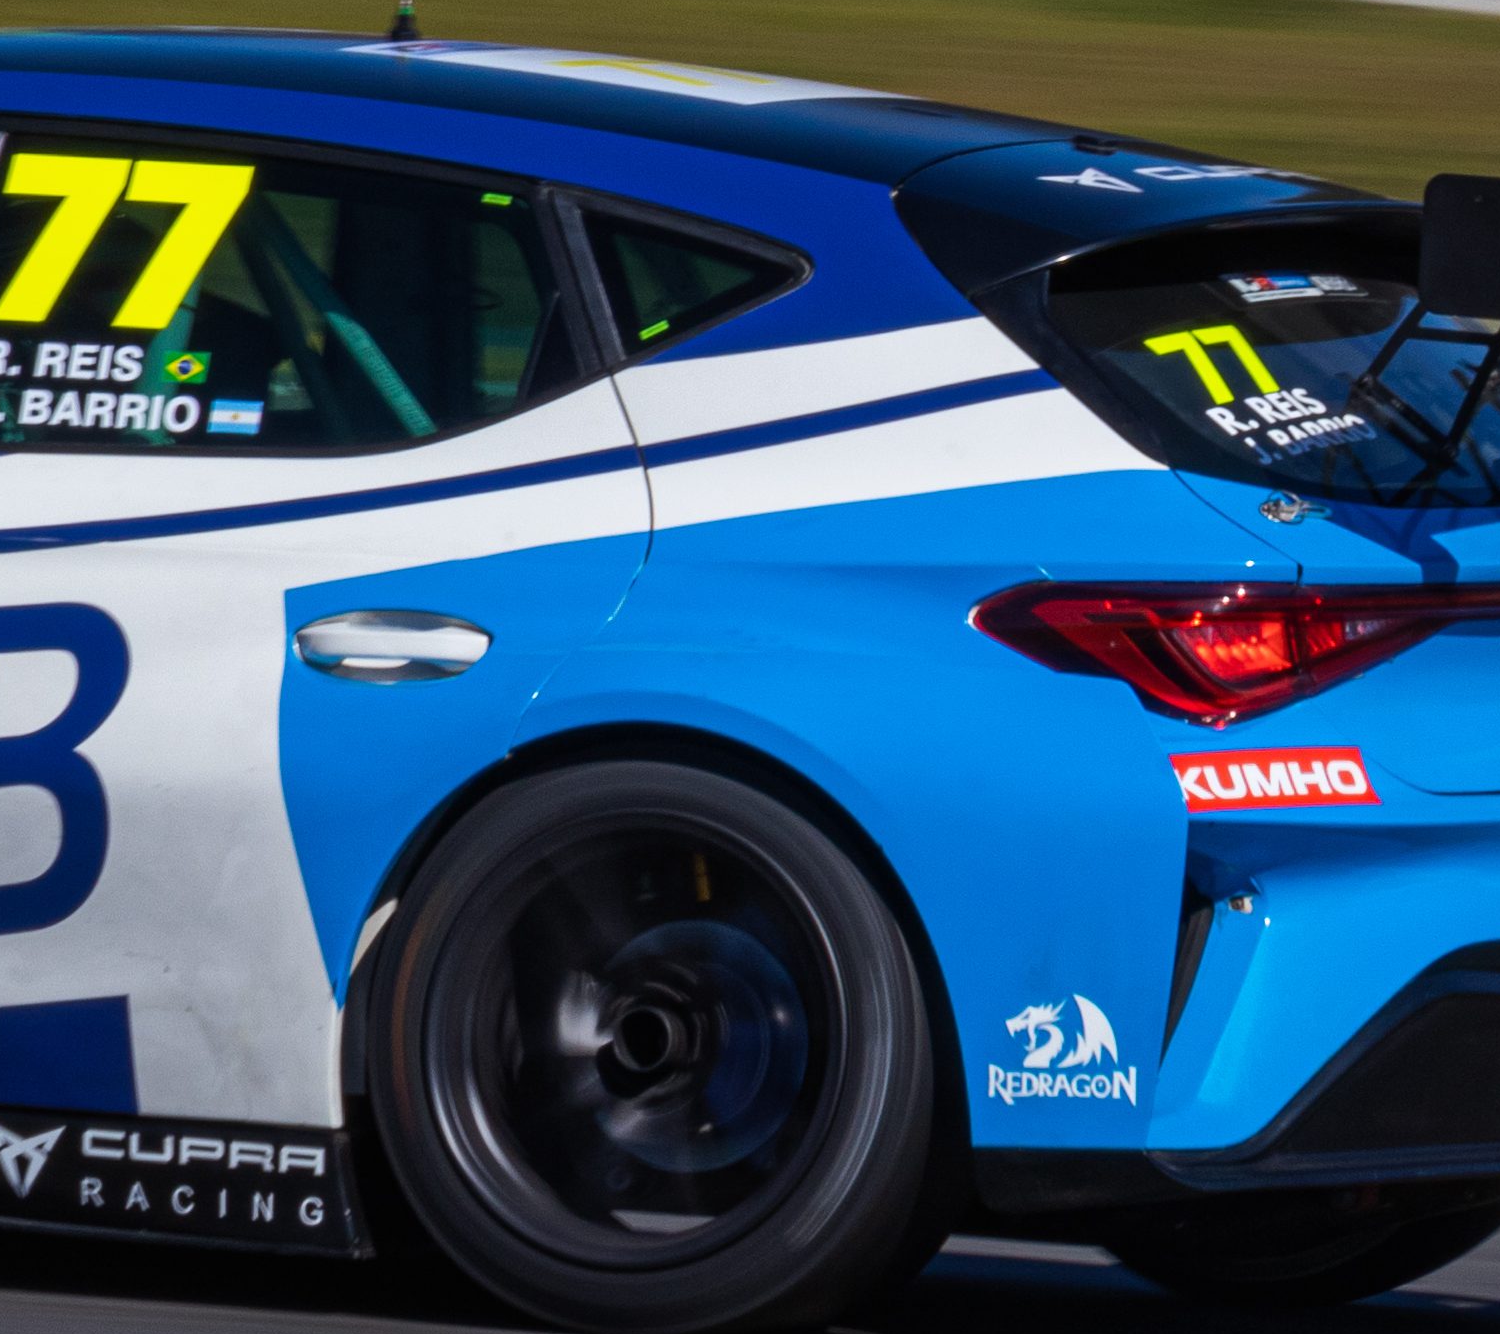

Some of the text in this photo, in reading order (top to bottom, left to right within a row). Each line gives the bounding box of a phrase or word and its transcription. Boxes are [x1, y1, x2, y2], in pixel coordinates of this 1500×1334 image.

[33, 341, 144, 382] REIS
[1143, 324, 1280, 405] 77
[17, 388, 201, 433] BARRIO
[1205, 388, 1327, 436] R. REIS
[1243, 413, 1378, 465] J. BARRIO
[1173, 760, 1369, 801] KUMHO
[988, 1063, 1137, 1107] REDRAGON
[81, 1129, 326, 1176] CUPRA
[80, 1176, 325, 1227] RACING
